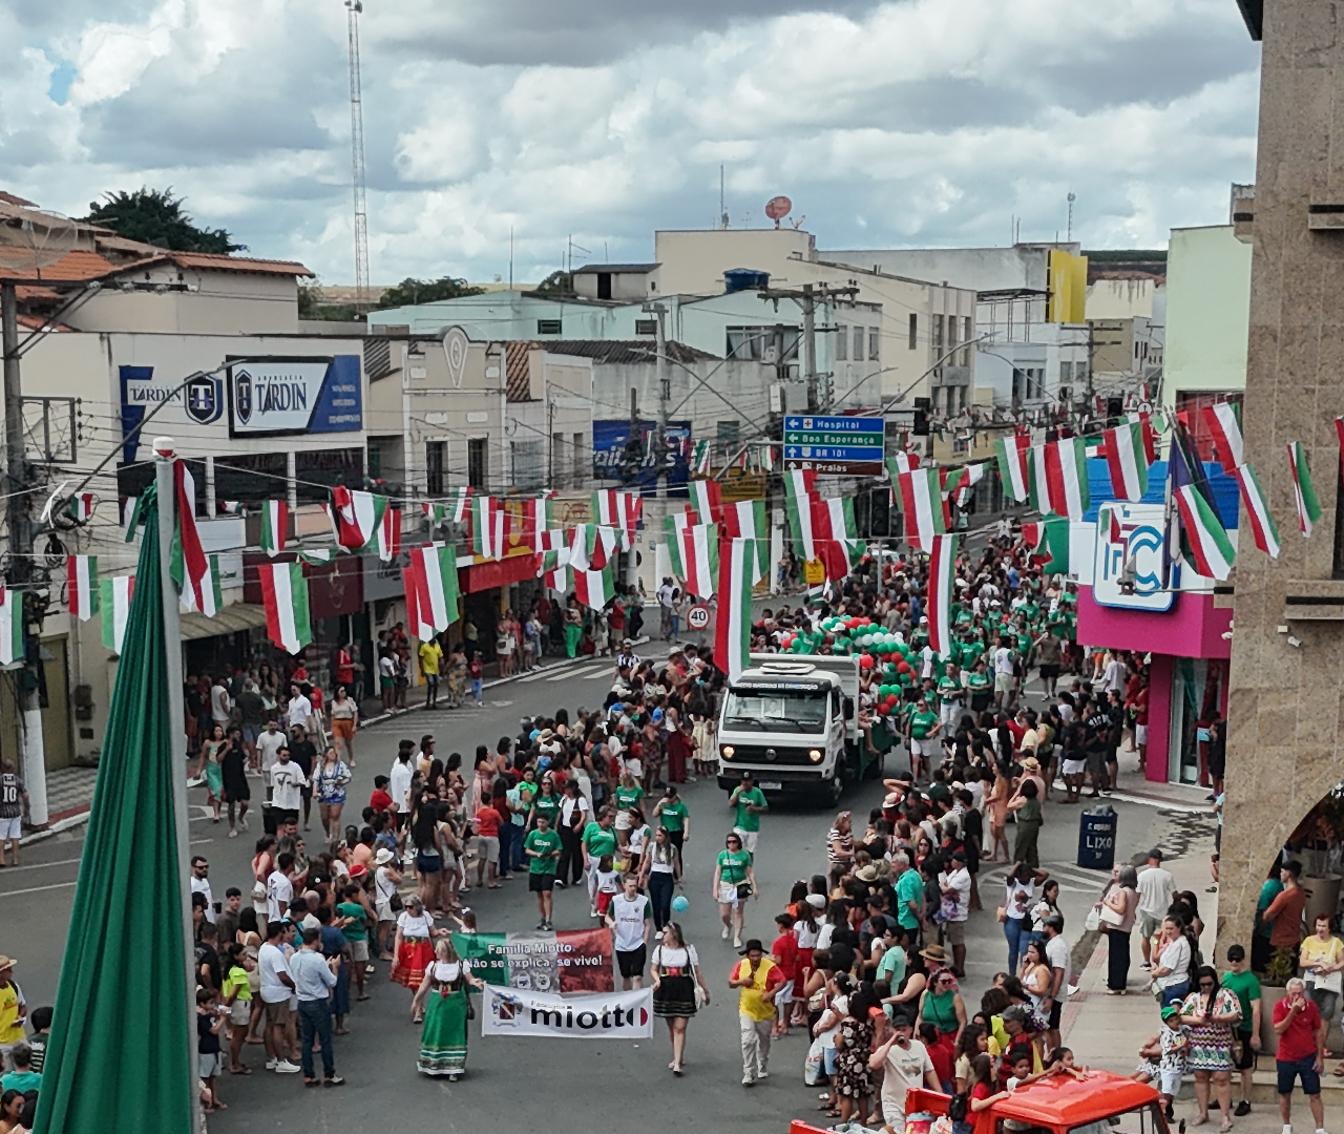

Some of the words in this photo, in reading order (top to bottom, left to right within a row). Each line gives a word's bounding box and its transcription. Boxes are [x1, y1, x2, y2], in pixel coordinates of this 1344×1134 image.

[255, 380, 307, 416] TARDIN
[817, 420, 860, 430] Hospital
[816, 463, 848, 472] Praias
[691, 609, 706, 622] 40
[2, 786, 17, 803] 10
[1086, 835, 1113, 849] LIXO
[490, 959, 504, 968] se
[557, 958, 571, 967] se
[574, 954, 603, 967] vive!
